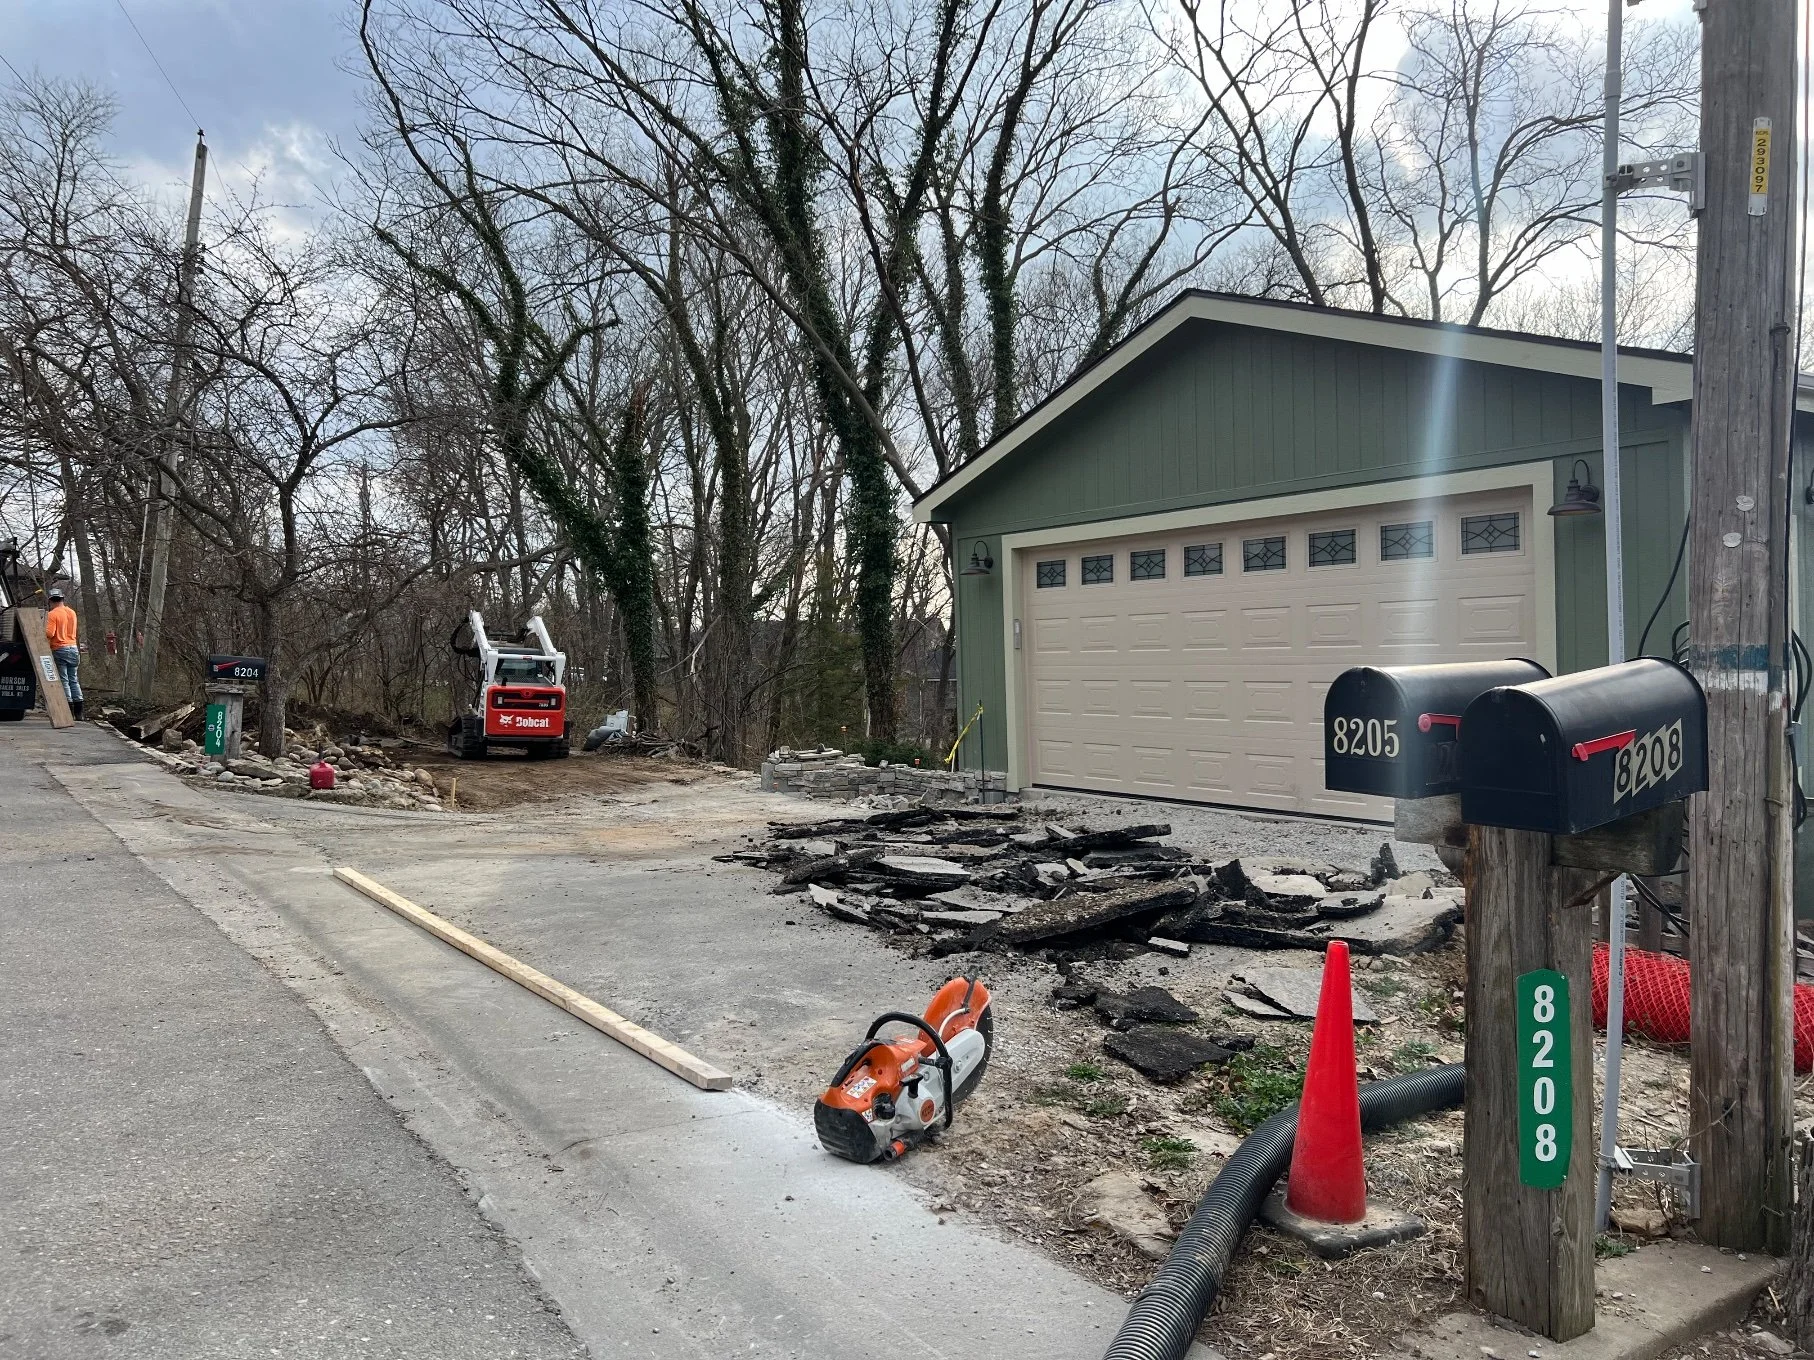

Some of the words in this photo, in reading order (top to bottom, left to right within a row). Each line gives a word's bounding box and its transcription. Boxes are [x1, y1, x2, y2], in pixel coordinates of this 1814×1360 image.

[1755, 138, 1767, 193] 293097
[234, 666, 259, 678] 8204
[215, 711, 224, 747] 8204
[515, 716, 549, 728] Bobcat
[1333, 716, 1400, 758] 8205
[1614, 726, 1682, 795] 8208
[1532, 984, 1557, 1162] 8208
